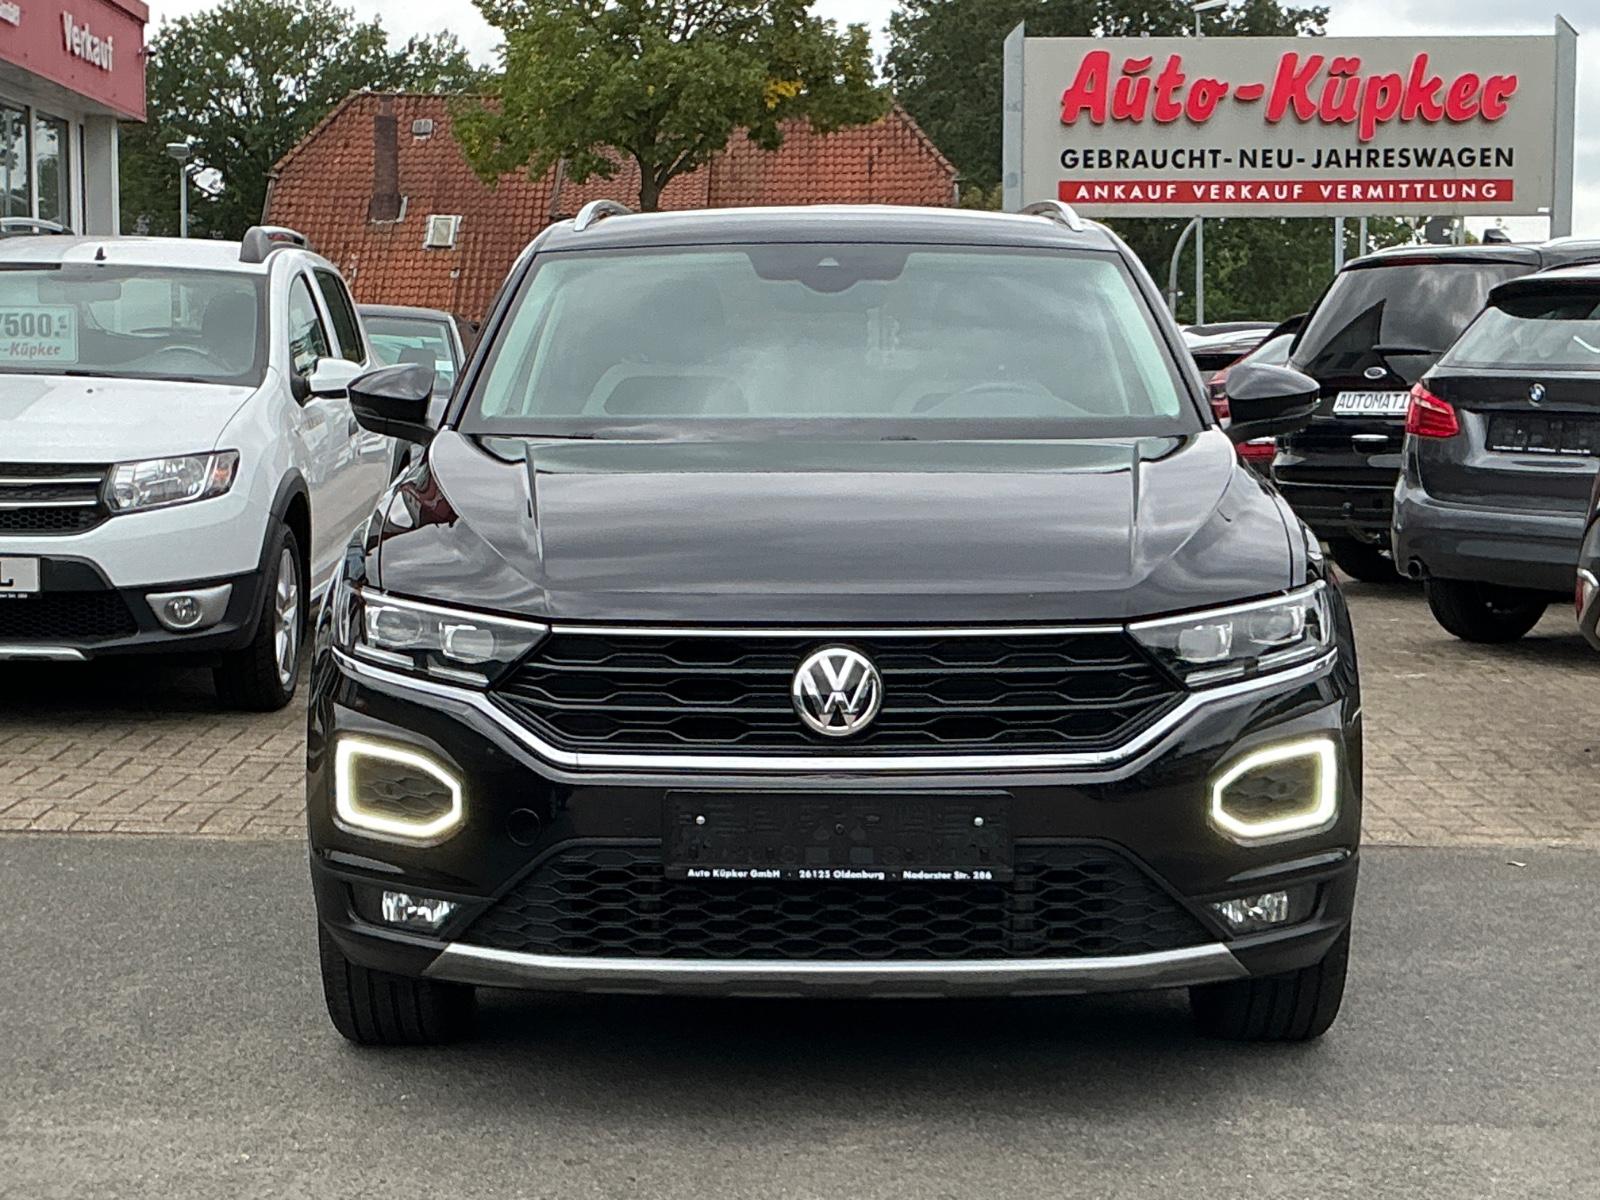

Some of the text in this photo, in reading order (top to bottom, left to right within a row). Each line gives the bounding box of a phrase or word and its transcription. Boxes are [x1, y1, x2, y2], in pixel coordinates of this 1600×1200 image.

[62, 10, 113, 72] Verkauf
[1076, 183, 1498, 200] ANKAUF VERKAUF VERMITTLUNG
[1336, 393, 1410, 409] AUTOMATI
[794, 648, 881, 736] VW
[687, 868, 711, 878] Auto
[712, 868, 748, 879] Küpker
[750, 868, 781, 879] GmbH
[799, 869, 831, 879] 26125
[832, 869, 885, 881] Oldenburg
[953, 870, 971, 880] Str.
